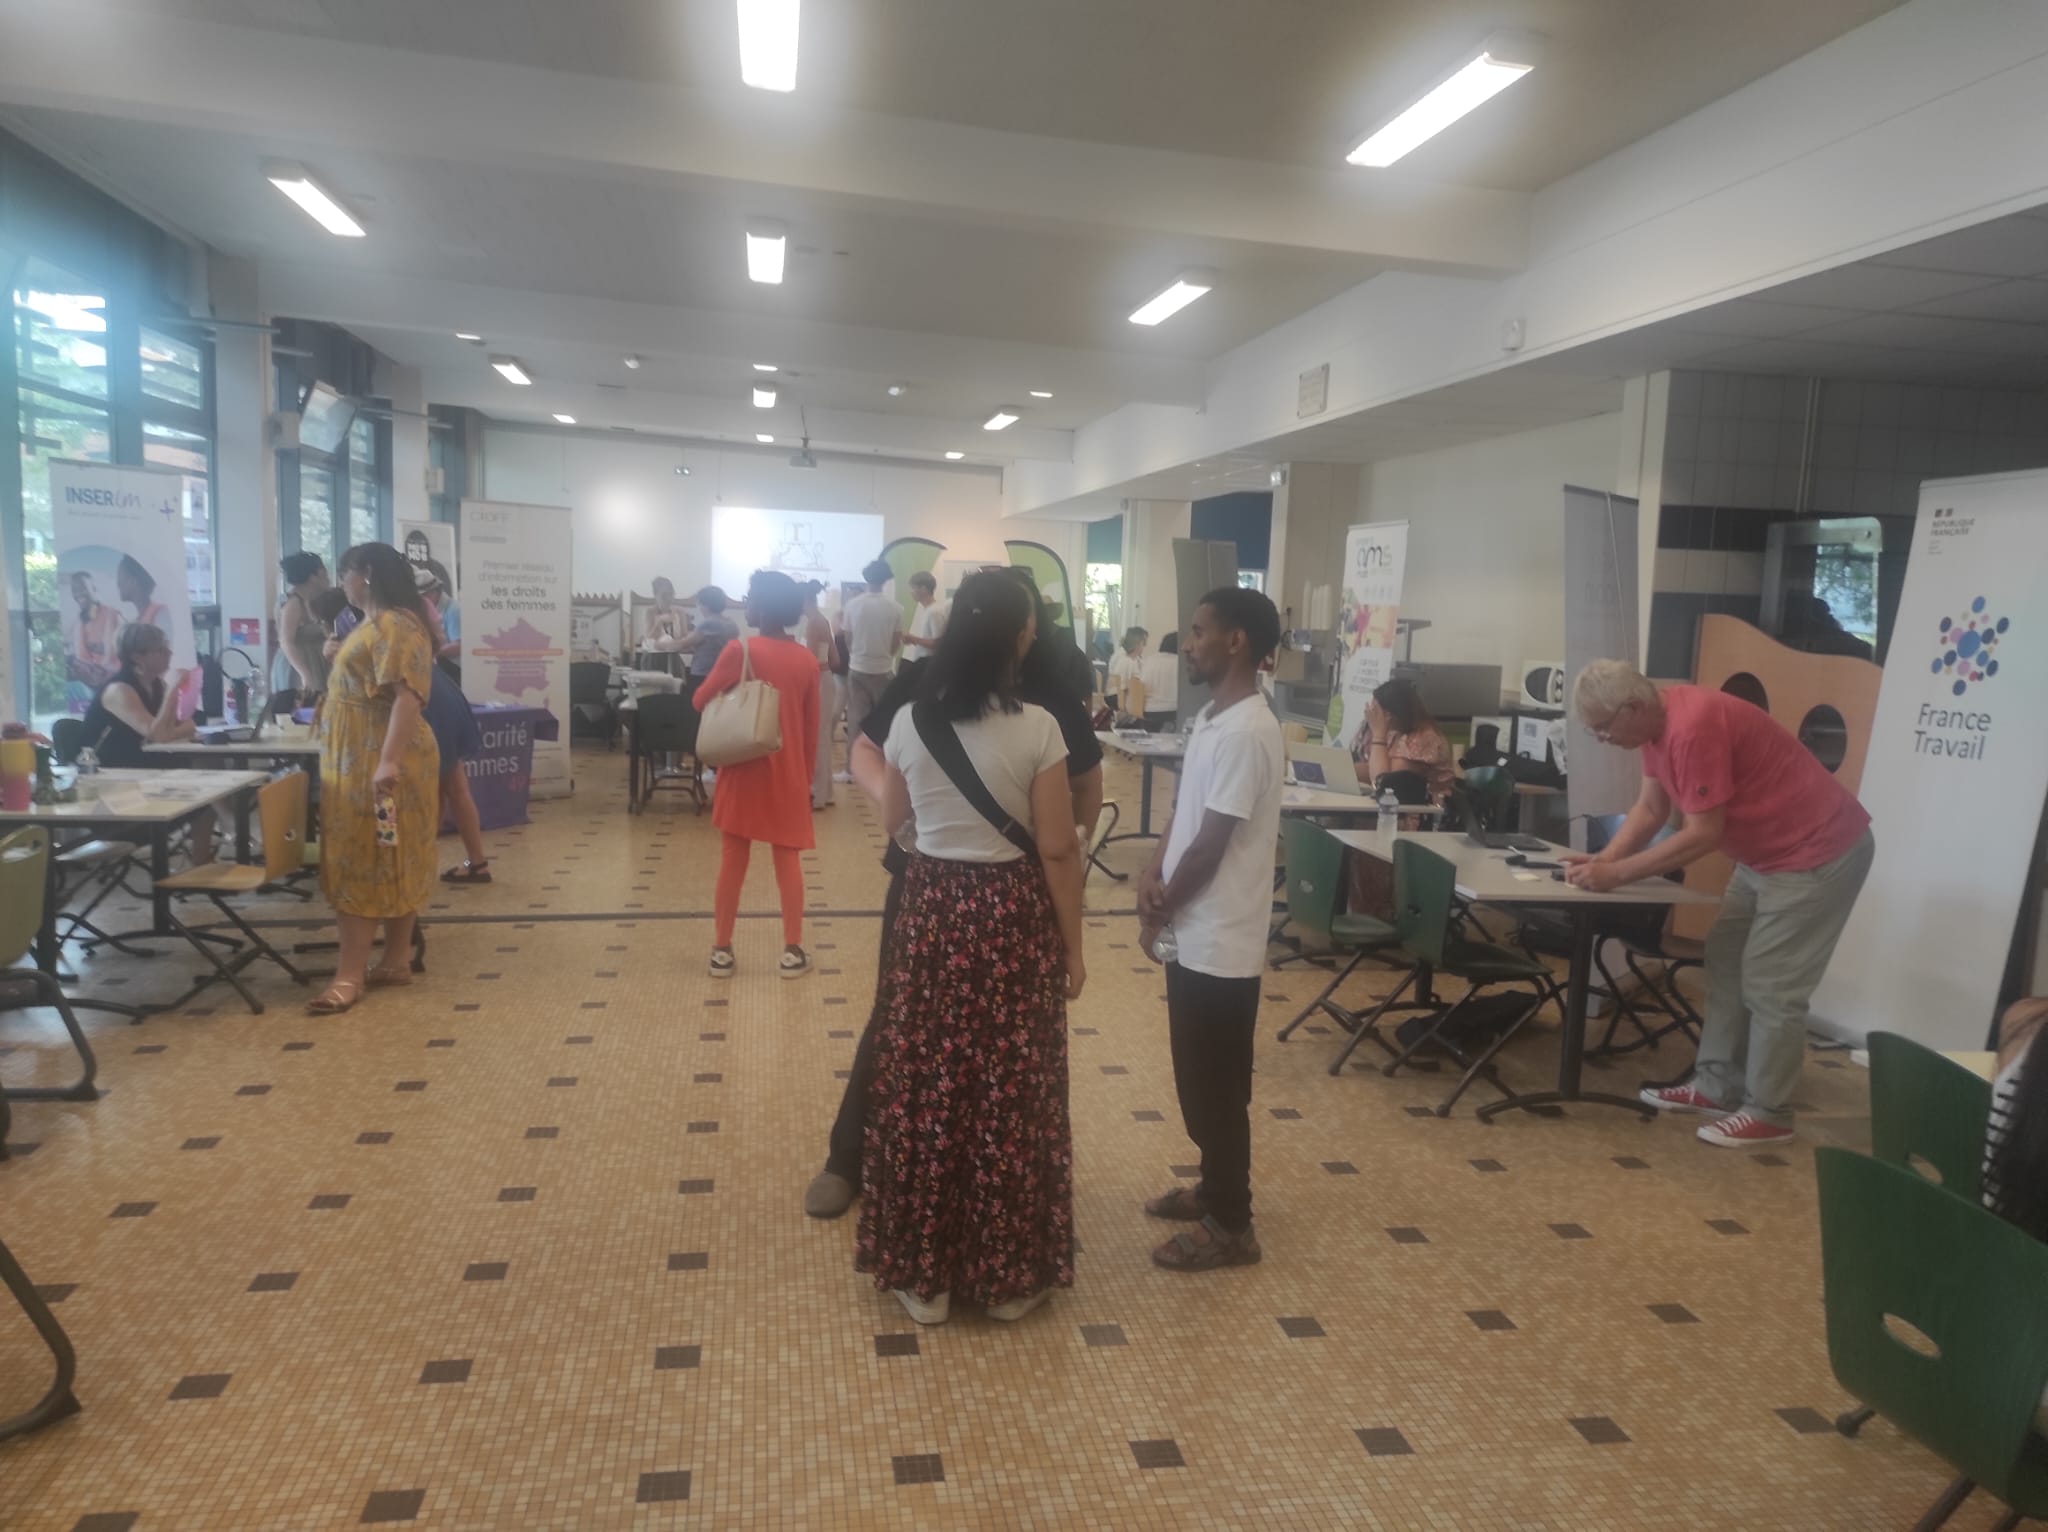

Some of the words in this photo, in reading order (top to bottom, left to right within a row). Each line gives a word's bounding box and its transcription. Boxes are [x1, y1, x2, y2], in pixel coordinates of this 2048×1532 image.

[491, 583, 508, 597] les
[511, 585, 547, 598] droits
[481, 597, 503, 610] des
[506, 598, 557, 611] femmes
[1917, 702, 1992, 732] France
[1913, 729, 1986, 761] Travail
